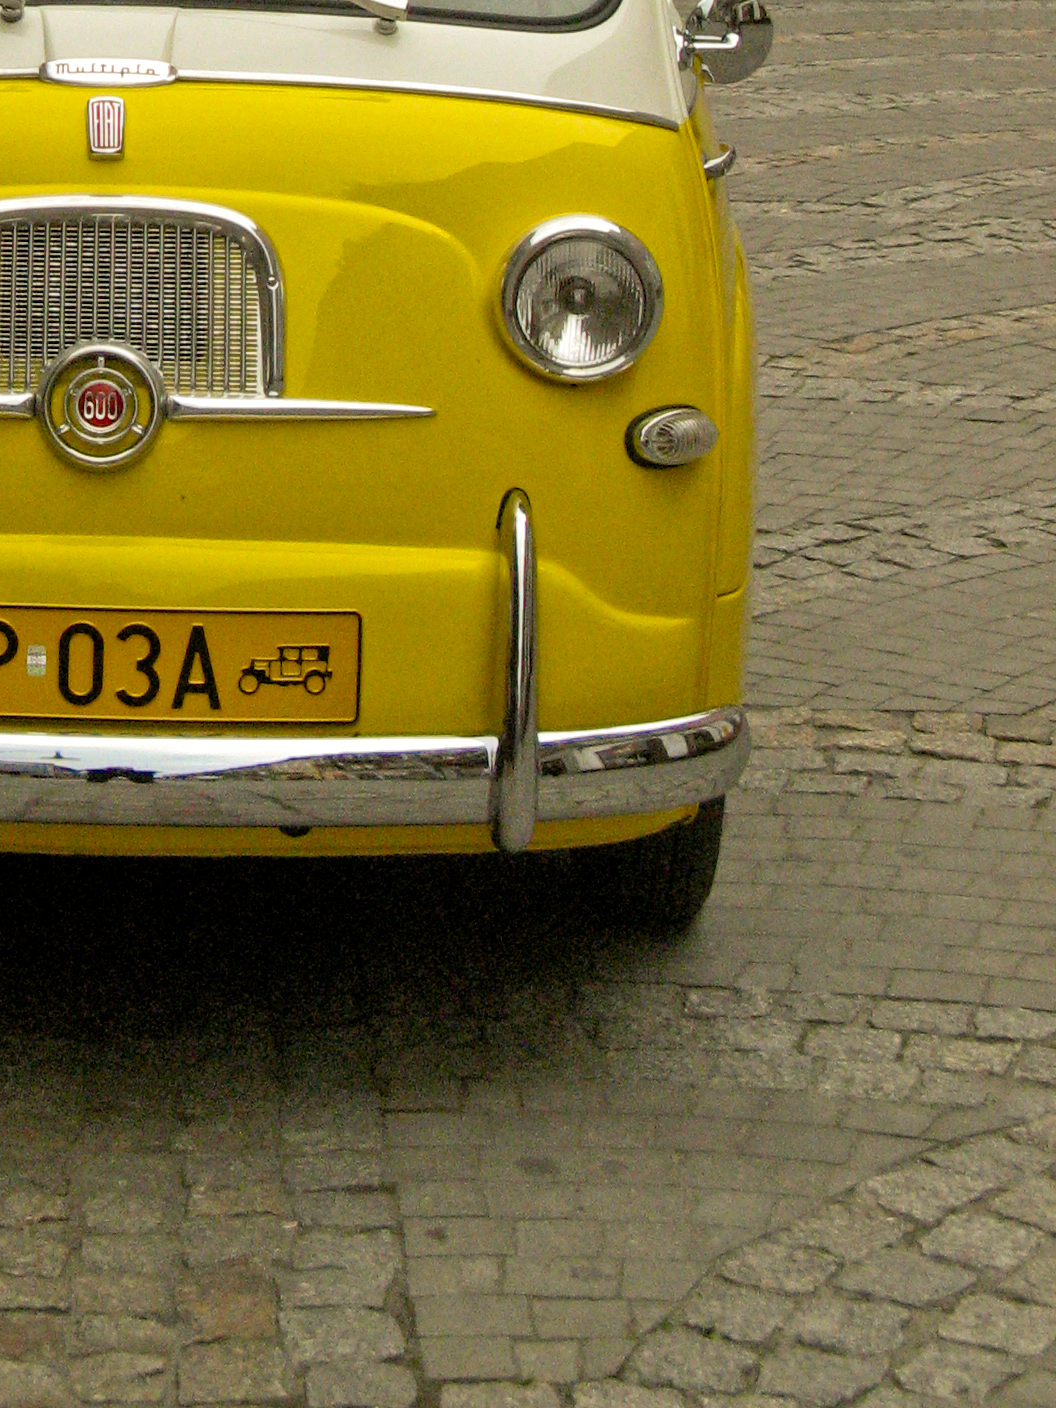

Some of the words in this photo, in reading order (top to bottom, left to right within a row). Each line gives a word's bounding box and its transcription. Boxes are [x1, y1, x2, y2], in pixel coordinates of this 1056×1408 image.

[93, 102, 121, 148] FIAT
[83, 391, 118, 420] 600
[57, 621, 222, 710] 03A
